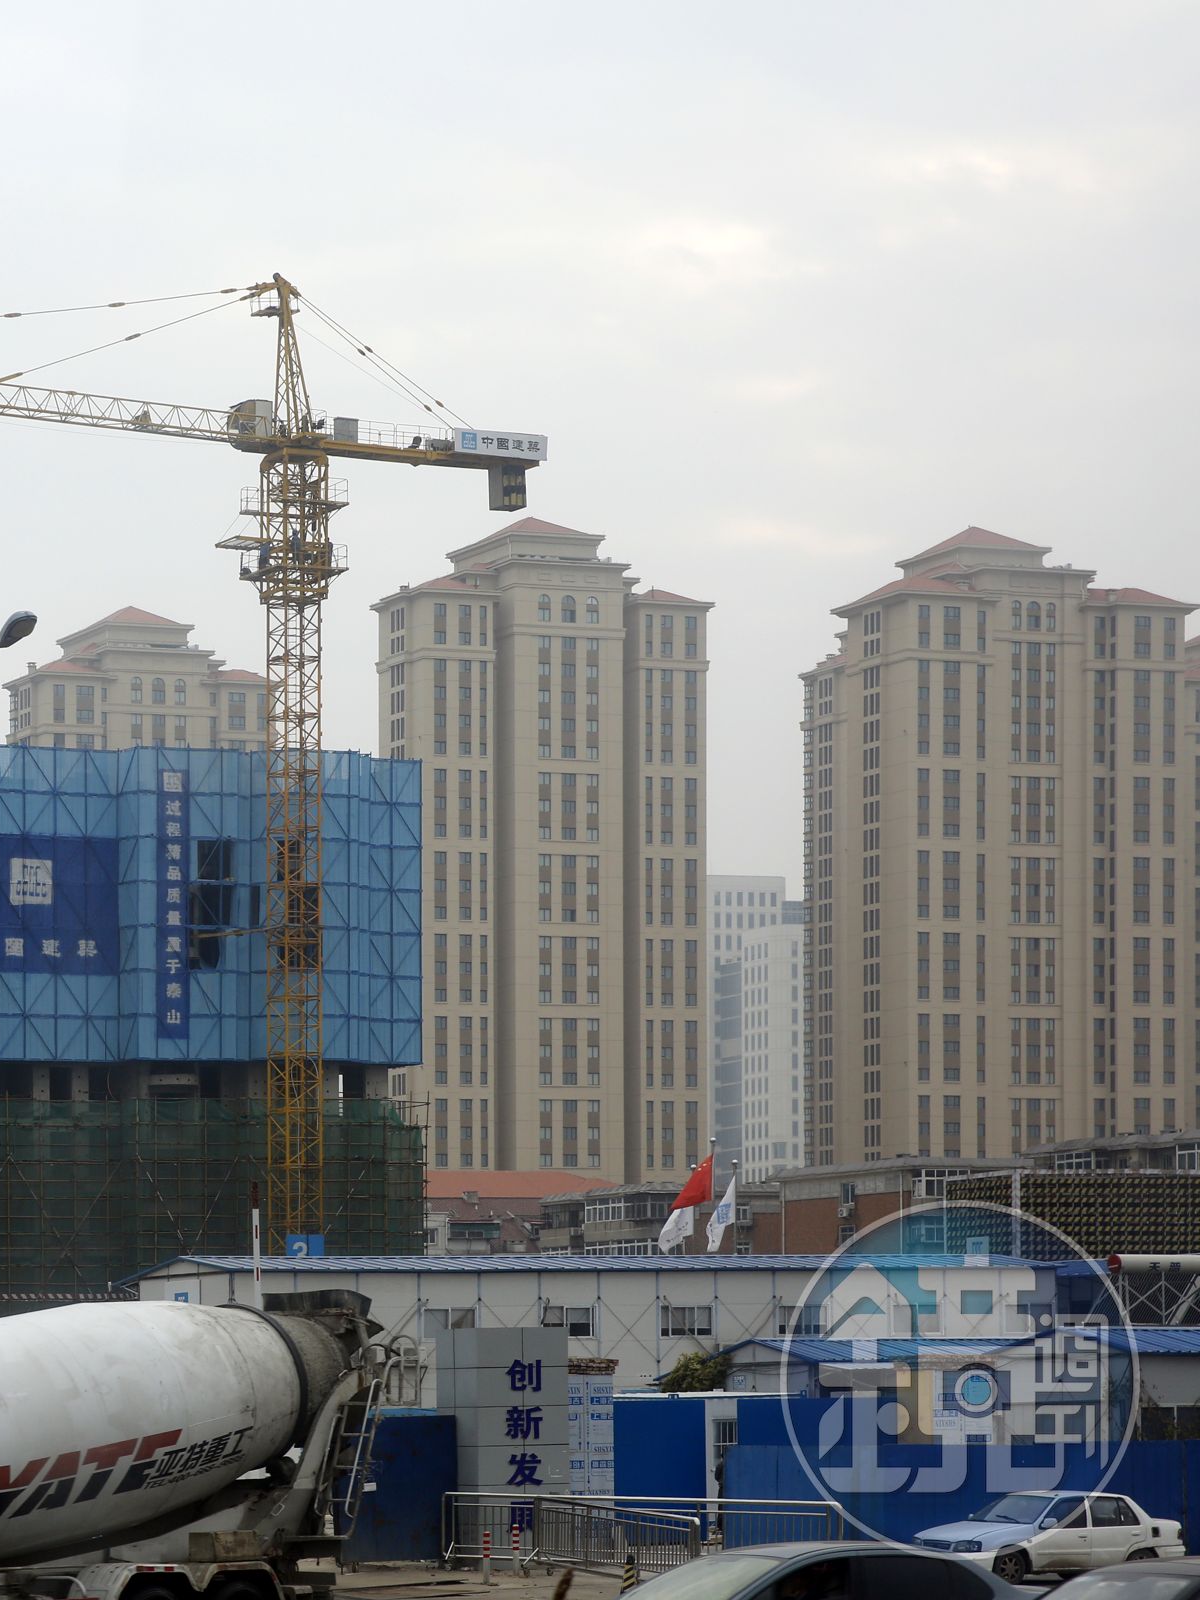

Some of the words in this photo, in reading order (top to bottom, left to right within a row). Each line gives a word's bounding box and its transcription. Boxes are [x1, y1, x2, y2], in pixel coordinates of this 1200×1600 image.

[165, 800, 183, 1025] 过程精品质量重于泰山
[149, 1426, 254, 1480] 亚特重工
[505, 1359, 544, 1533] 创新发展
